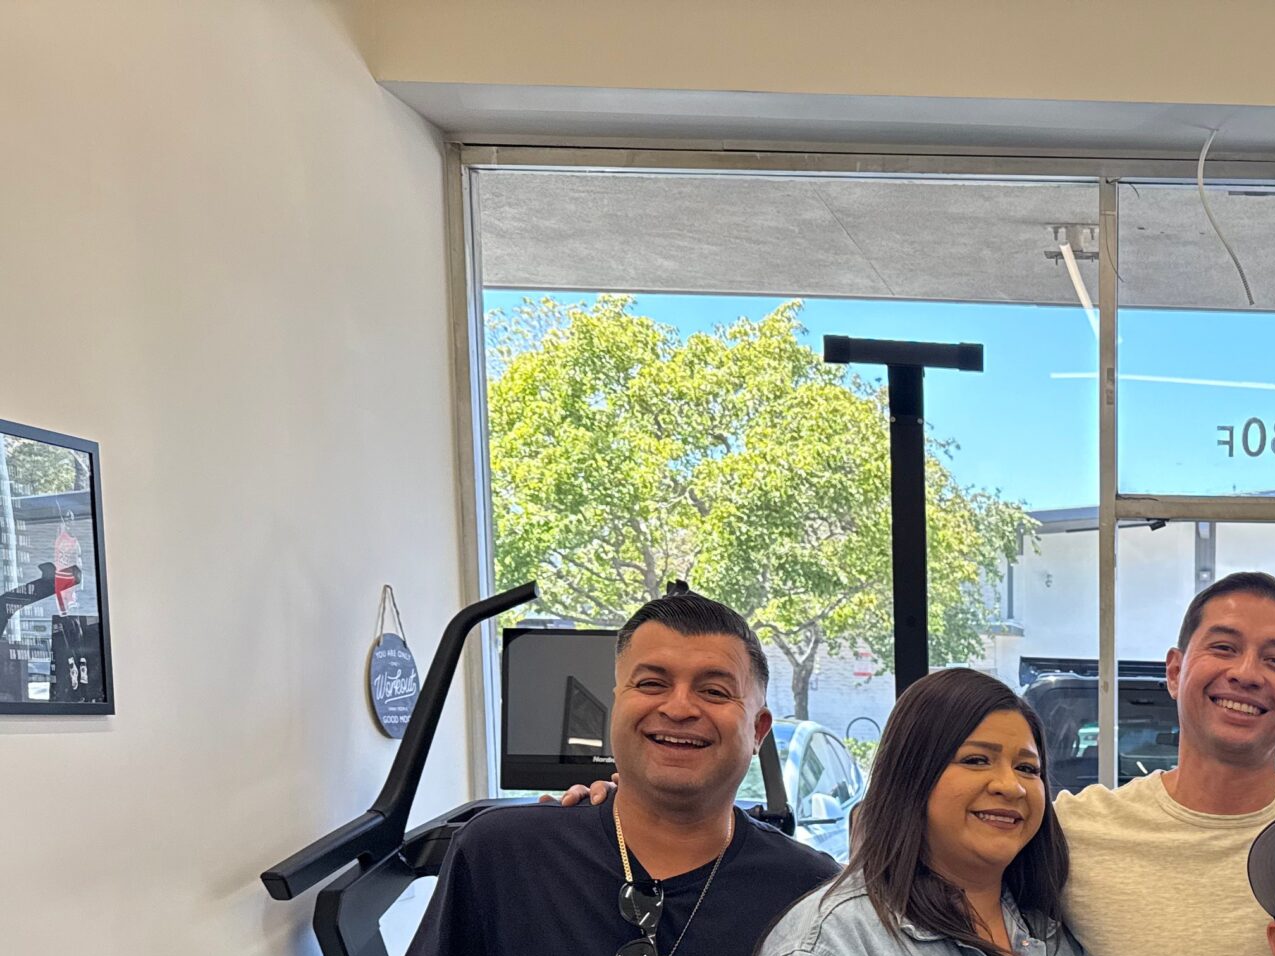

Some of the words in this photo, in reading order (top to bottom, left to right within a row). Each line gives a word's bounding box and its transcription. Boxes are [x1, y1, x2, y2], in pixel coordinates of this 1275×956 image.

[376, 650, 386, 659] YOU
[387, 649, 396, 657] ARE
[398, 650, 411, 660] ONLY
[374, 669, 416, 704] Workout
